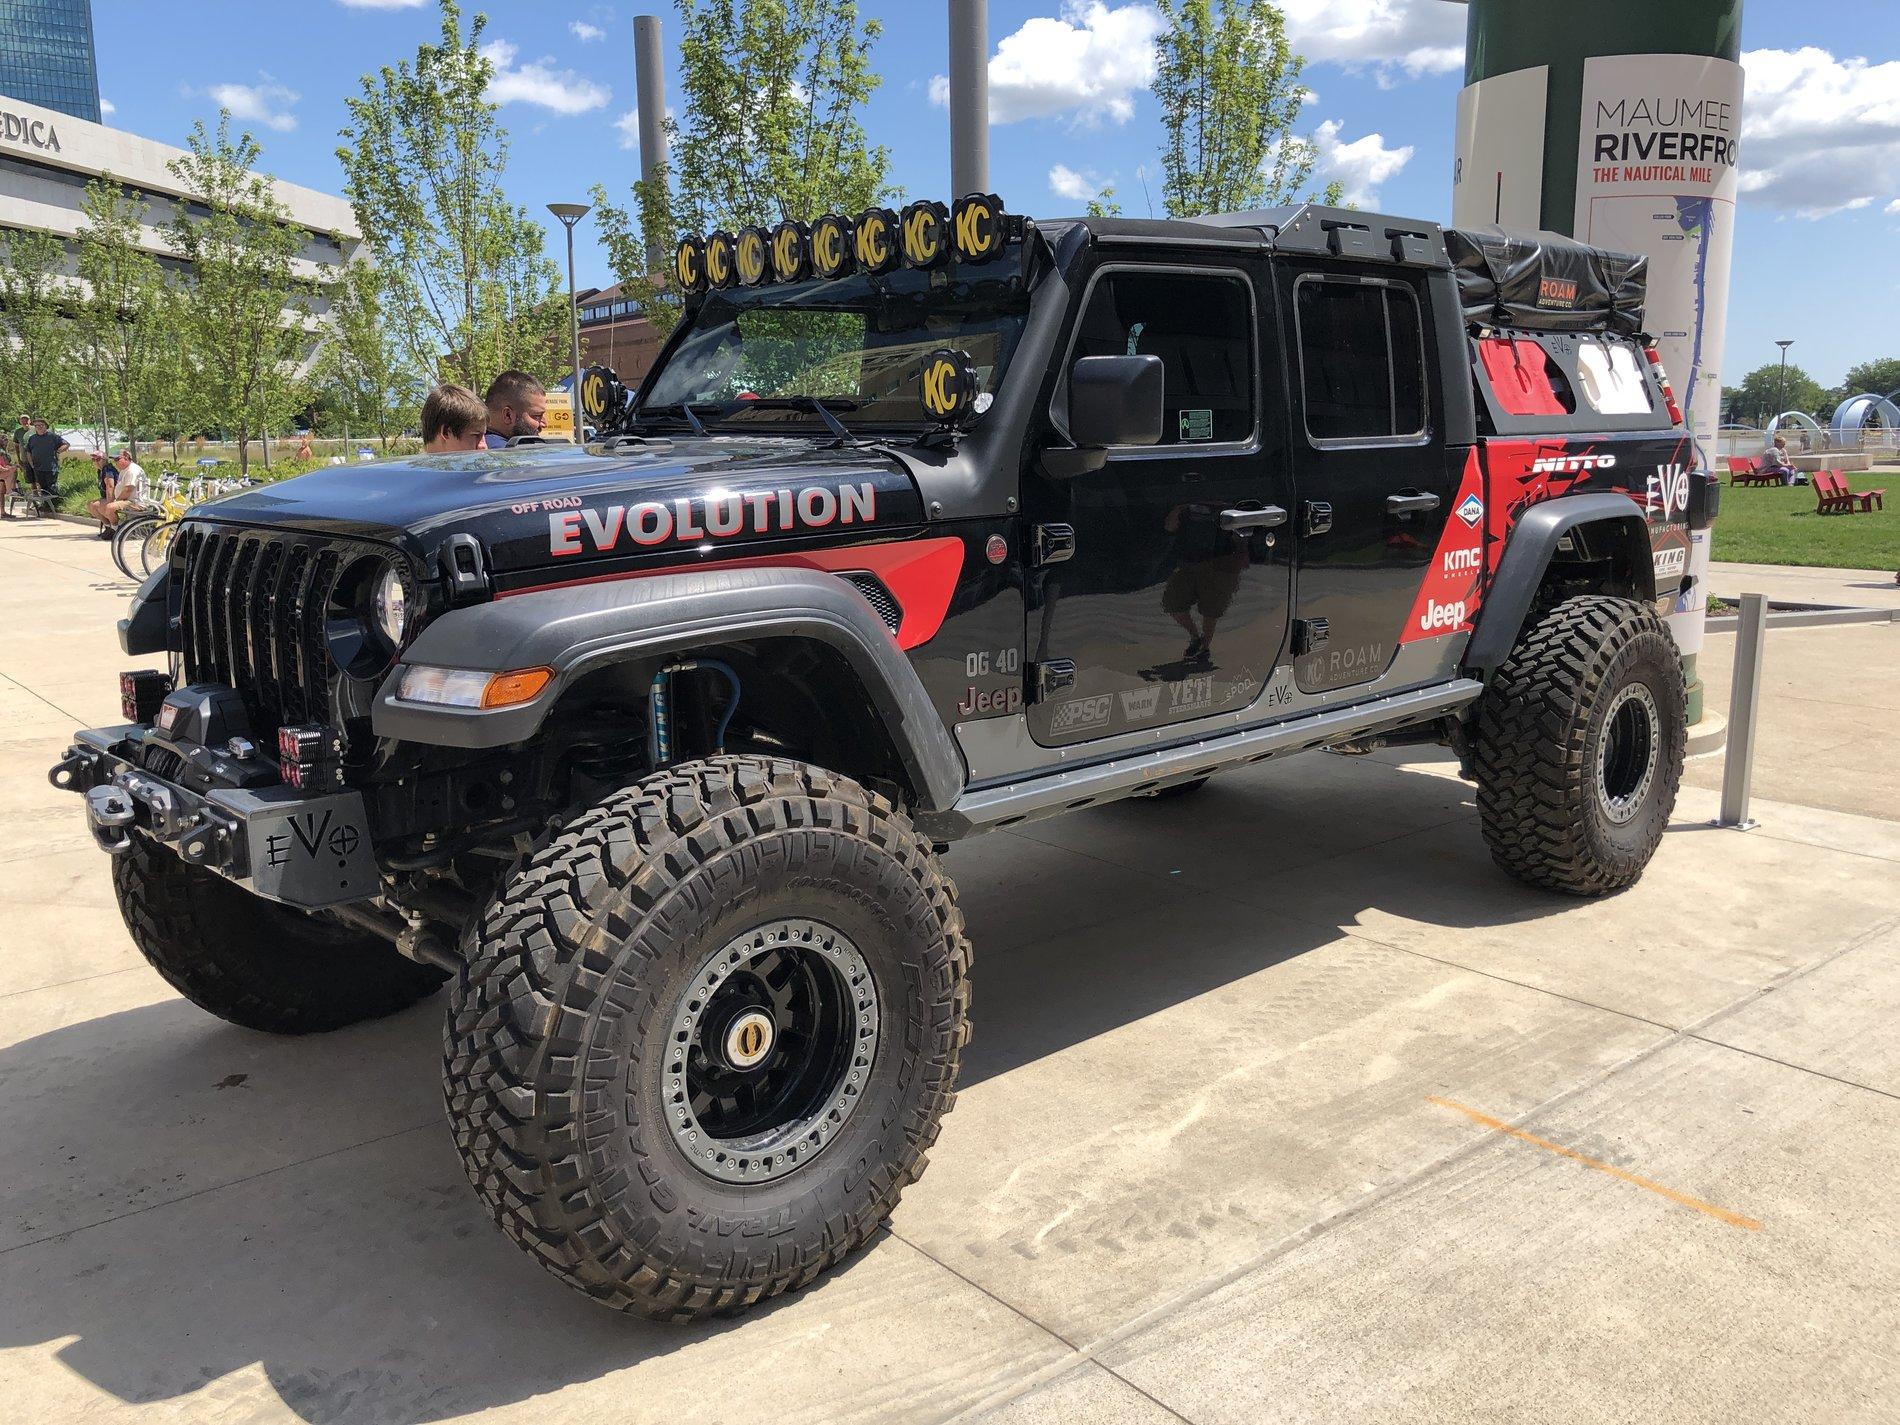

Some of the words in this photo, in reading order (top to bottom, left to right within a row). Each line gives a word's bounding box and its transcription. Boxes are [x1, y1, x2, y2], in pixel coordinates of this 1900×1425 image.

[1596, 98, 1731, 132] MAUMEE
[1594, 131, 1739, 168] RIVERFRO
[1593, 167, 1619, 183] THE
[1623, 165, 1686, 182] NAUTICAL
[1689, 166, 1713, 183] MILE
[856, 217, 886, 267] KC
[904, 210, 936, 262] KC
[956, 202, 991, 257] KC
[677, 243, 696, 285] KC
[706, 237, 727, 285] KC
[738, 237, 761, 284] KC
[773, 228, 799, 276] KC
[813, 223, 841, 272] KC
[1538, 298, 1565, 308] ADVENTURE
[1540, 280, 1577, 300] ROAM
[583, 374, 605, 416] KC
[924, 360, 958, 416] KC
[1532, 454, 1616, 473] NITTO
[511, 501, 539, 515] OFF
[541, 496, 583, 511] ROAD
[1646, 463, 1690, 521] EVO
[549, 482, 876, 557] EVOLUTION
[1463, 506, 1480, 516] DANA
[1654, 550, 1684, 567] KING
[1420, 598, 1466, 631] Jeep
[966, 651, 990, 678] OG
[995, 648, 1018, 674] 40
[1329, 643, 1382, 671] ROAM
[957, 685, 1023, 716] Jeep
[1168, 675, 1214, 706] YETI
[1066, 698, 1109, 726] PSC
[266, 809, 360, 869] EVO
